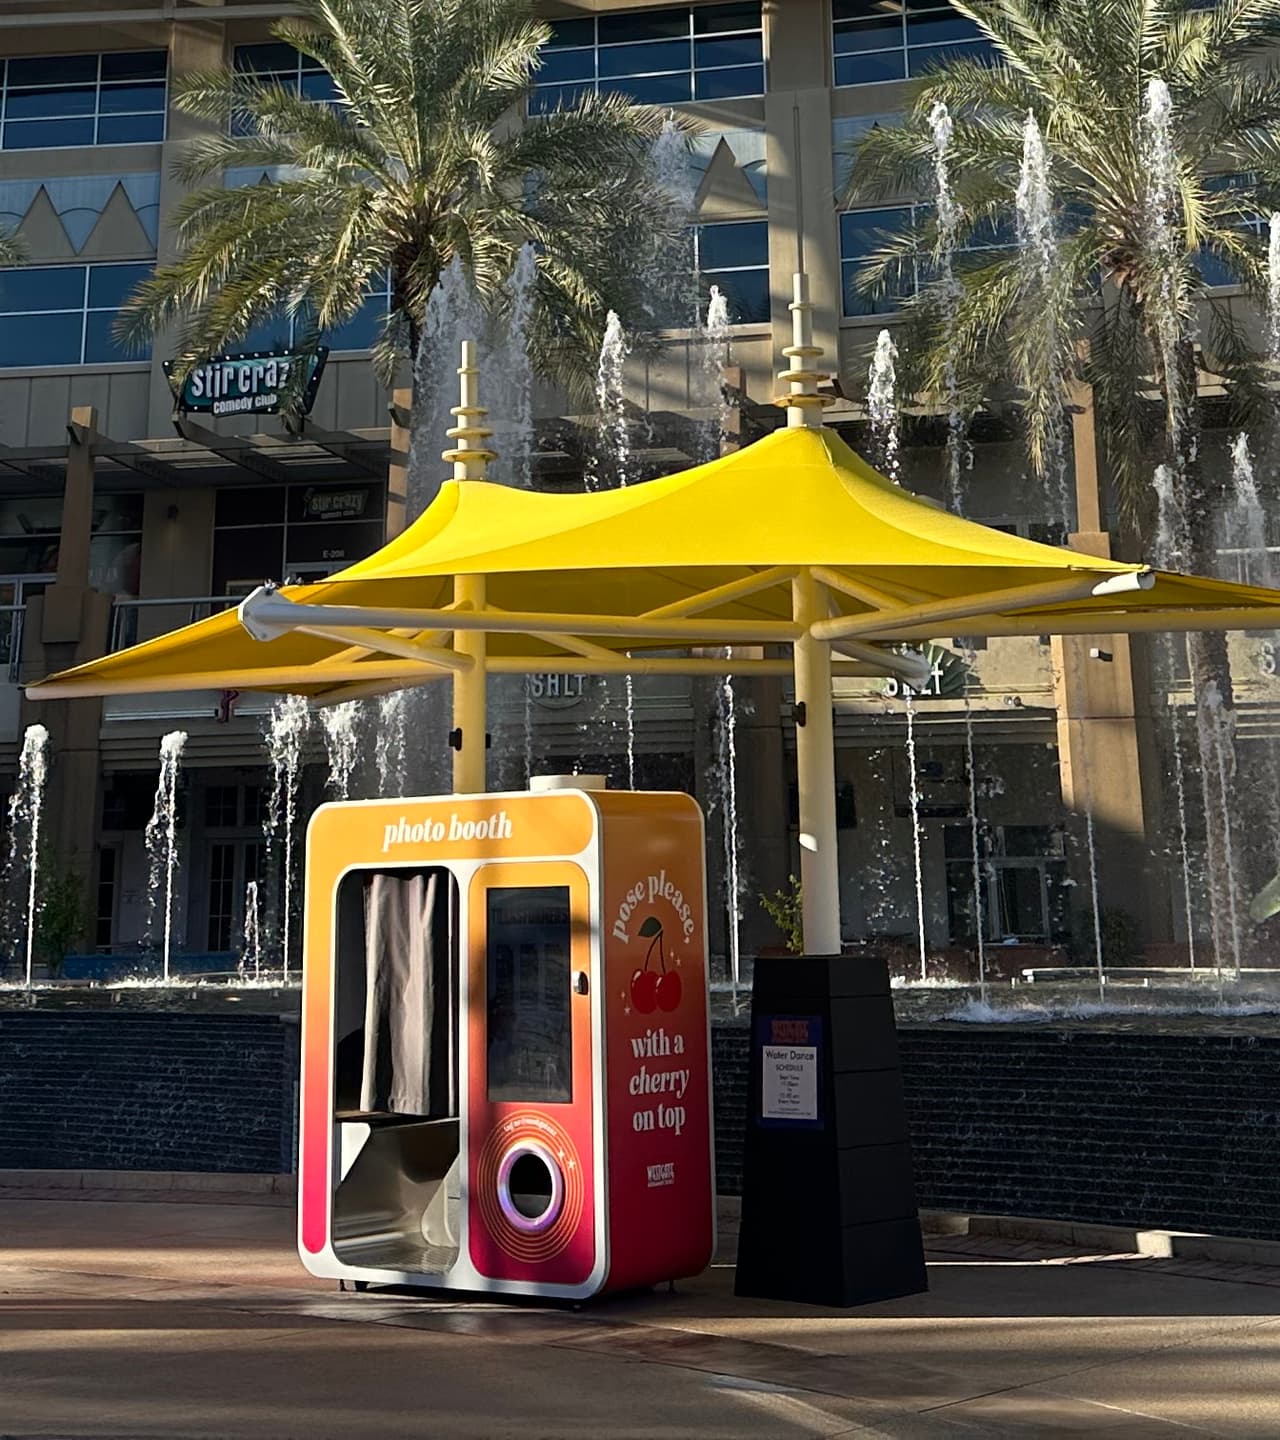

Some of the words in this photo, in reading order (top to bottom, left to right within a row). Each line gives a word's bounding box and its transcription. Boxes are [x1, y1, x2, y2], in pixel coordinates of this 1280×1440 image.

[191, 363, 234, 398] stir
[238, 360, 297, 394] craz
[213, 397, 253, 414] comedy
[255, 394, 277, 408] club
[531, 674, 586, 697] SALT
[381, 816, 445, 853] photo
[448, 811, 512, 841] booth
[612, 881, 646, 944] pose
[631, 1028, 671, 1058] with
[674, 1035, 684, 1055] a
[765, 1050, 788, 1061] Water
[790, 1050, 814, 1061] Dance
[629, 1066, 690, 1099] cherry
[633, 1112, 656, 1132] on
[657, 1104, 686, 1136] top
